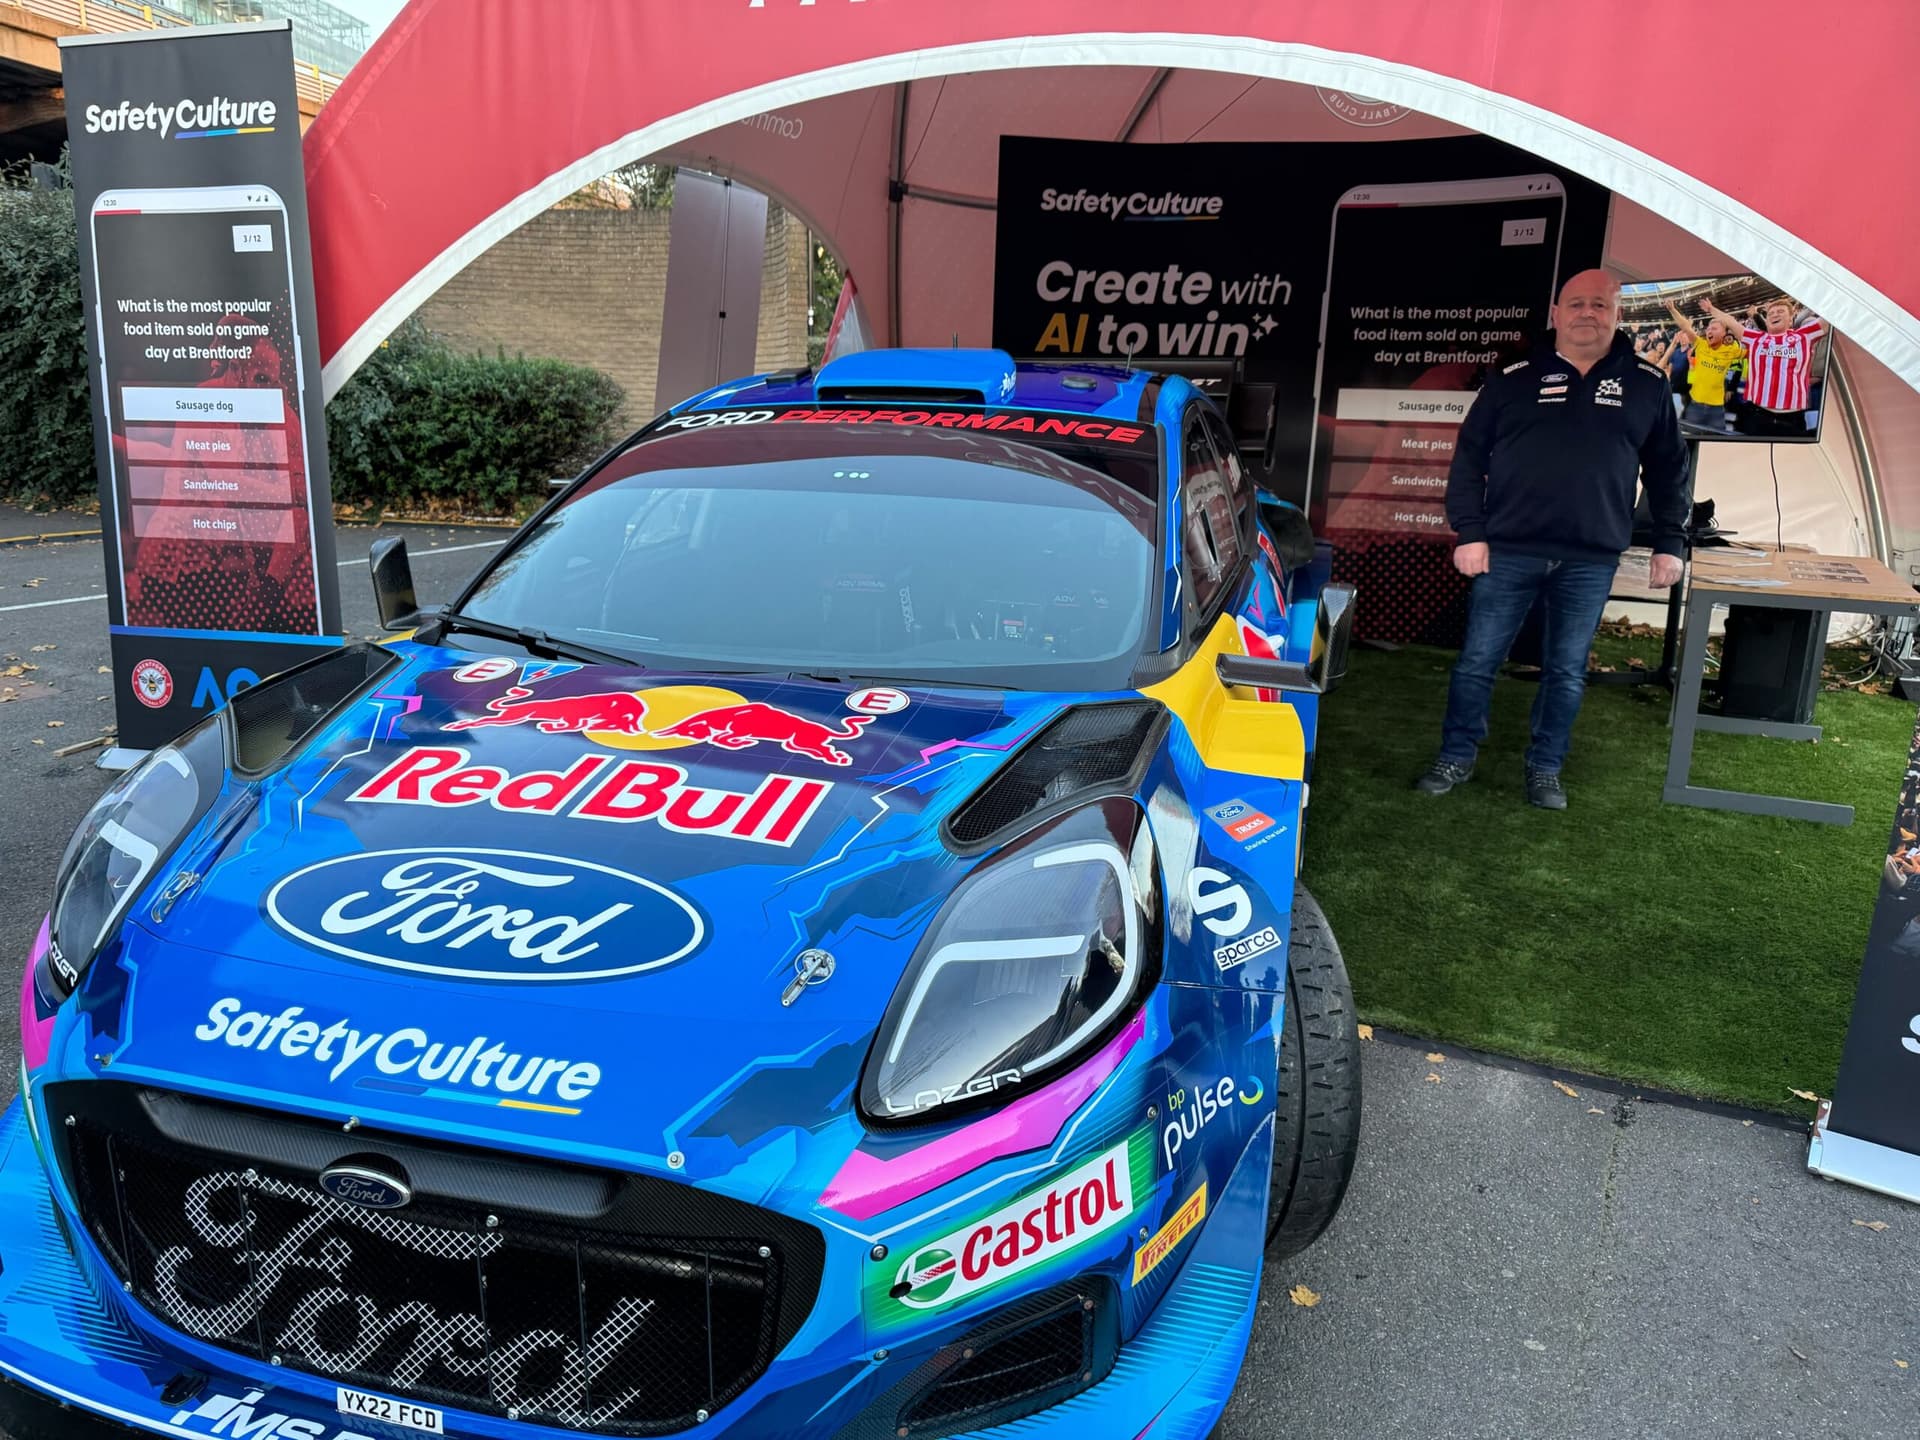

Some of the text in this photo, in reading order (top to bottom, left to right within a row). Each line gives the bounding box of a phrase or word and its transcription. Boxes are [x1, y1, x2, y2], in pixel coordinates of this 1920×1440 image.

[85, 96, 276, 139] SafetyCulture
[1040, 188, 1224, 222] SafetyCulture
[1036, 260, 1292, 305] Create with
[117, 298, 272, 317] What is the most popular
[1350, 306, 1530, 323] What is the most popular
[123, 321, 270, 340] food item sold on game
[1034, 310, 1250, 356] AI to win
[1353, 327, 1522, 345] food item sold on game
[145, 345, 253, 363] day at Brentford?
[1374, 350, 1499, 367] day at Brentford?
[175, 400, 234, 413] Sausage dog
[1397, 401, 1464, 414] Sausage dog
[655, 409, 1146, 445] FORD PERFORMANCE
[185, 440, 232, 454] Meat pies
[1401, 439, 1453, 452] Meat pies
[183, 479, 239, 491] Sandwiches
[1391, 475, 1449, 488] Sandwiche
[193, 519, 237, 533] Hot chips
[1394, 511, 1444, 526] Hot chips
[464, 662, 501, 679] E
[863, 692, 897, 710] E
[353, 746, 832, 846] Red Bull
[1219, 806, 1241, 818] Ford
[1235, 818, 1265, 835] TRUCKS
[319, 857, 635, 967] Ford
[1216, 929, 1276, 967] sparco
[195, 997, 602, 1101] SafetyCulture
[885, 1068, 1022, 1114] LAZER
[1167, 1088, 1186, 1112] bp
[1163, 1076, 1235, 1171] pulse
[336, 1176, 387, 1204] Ford
[961, 1158, 1124, 1282] Castrol
[1139, 1194, 1202, 1275] PIRELLI
[154, 1171, 656, 1428] Ford
[342, 1390, 392, 1419] YX22
[398, 1405, 438, 1430] FCD
